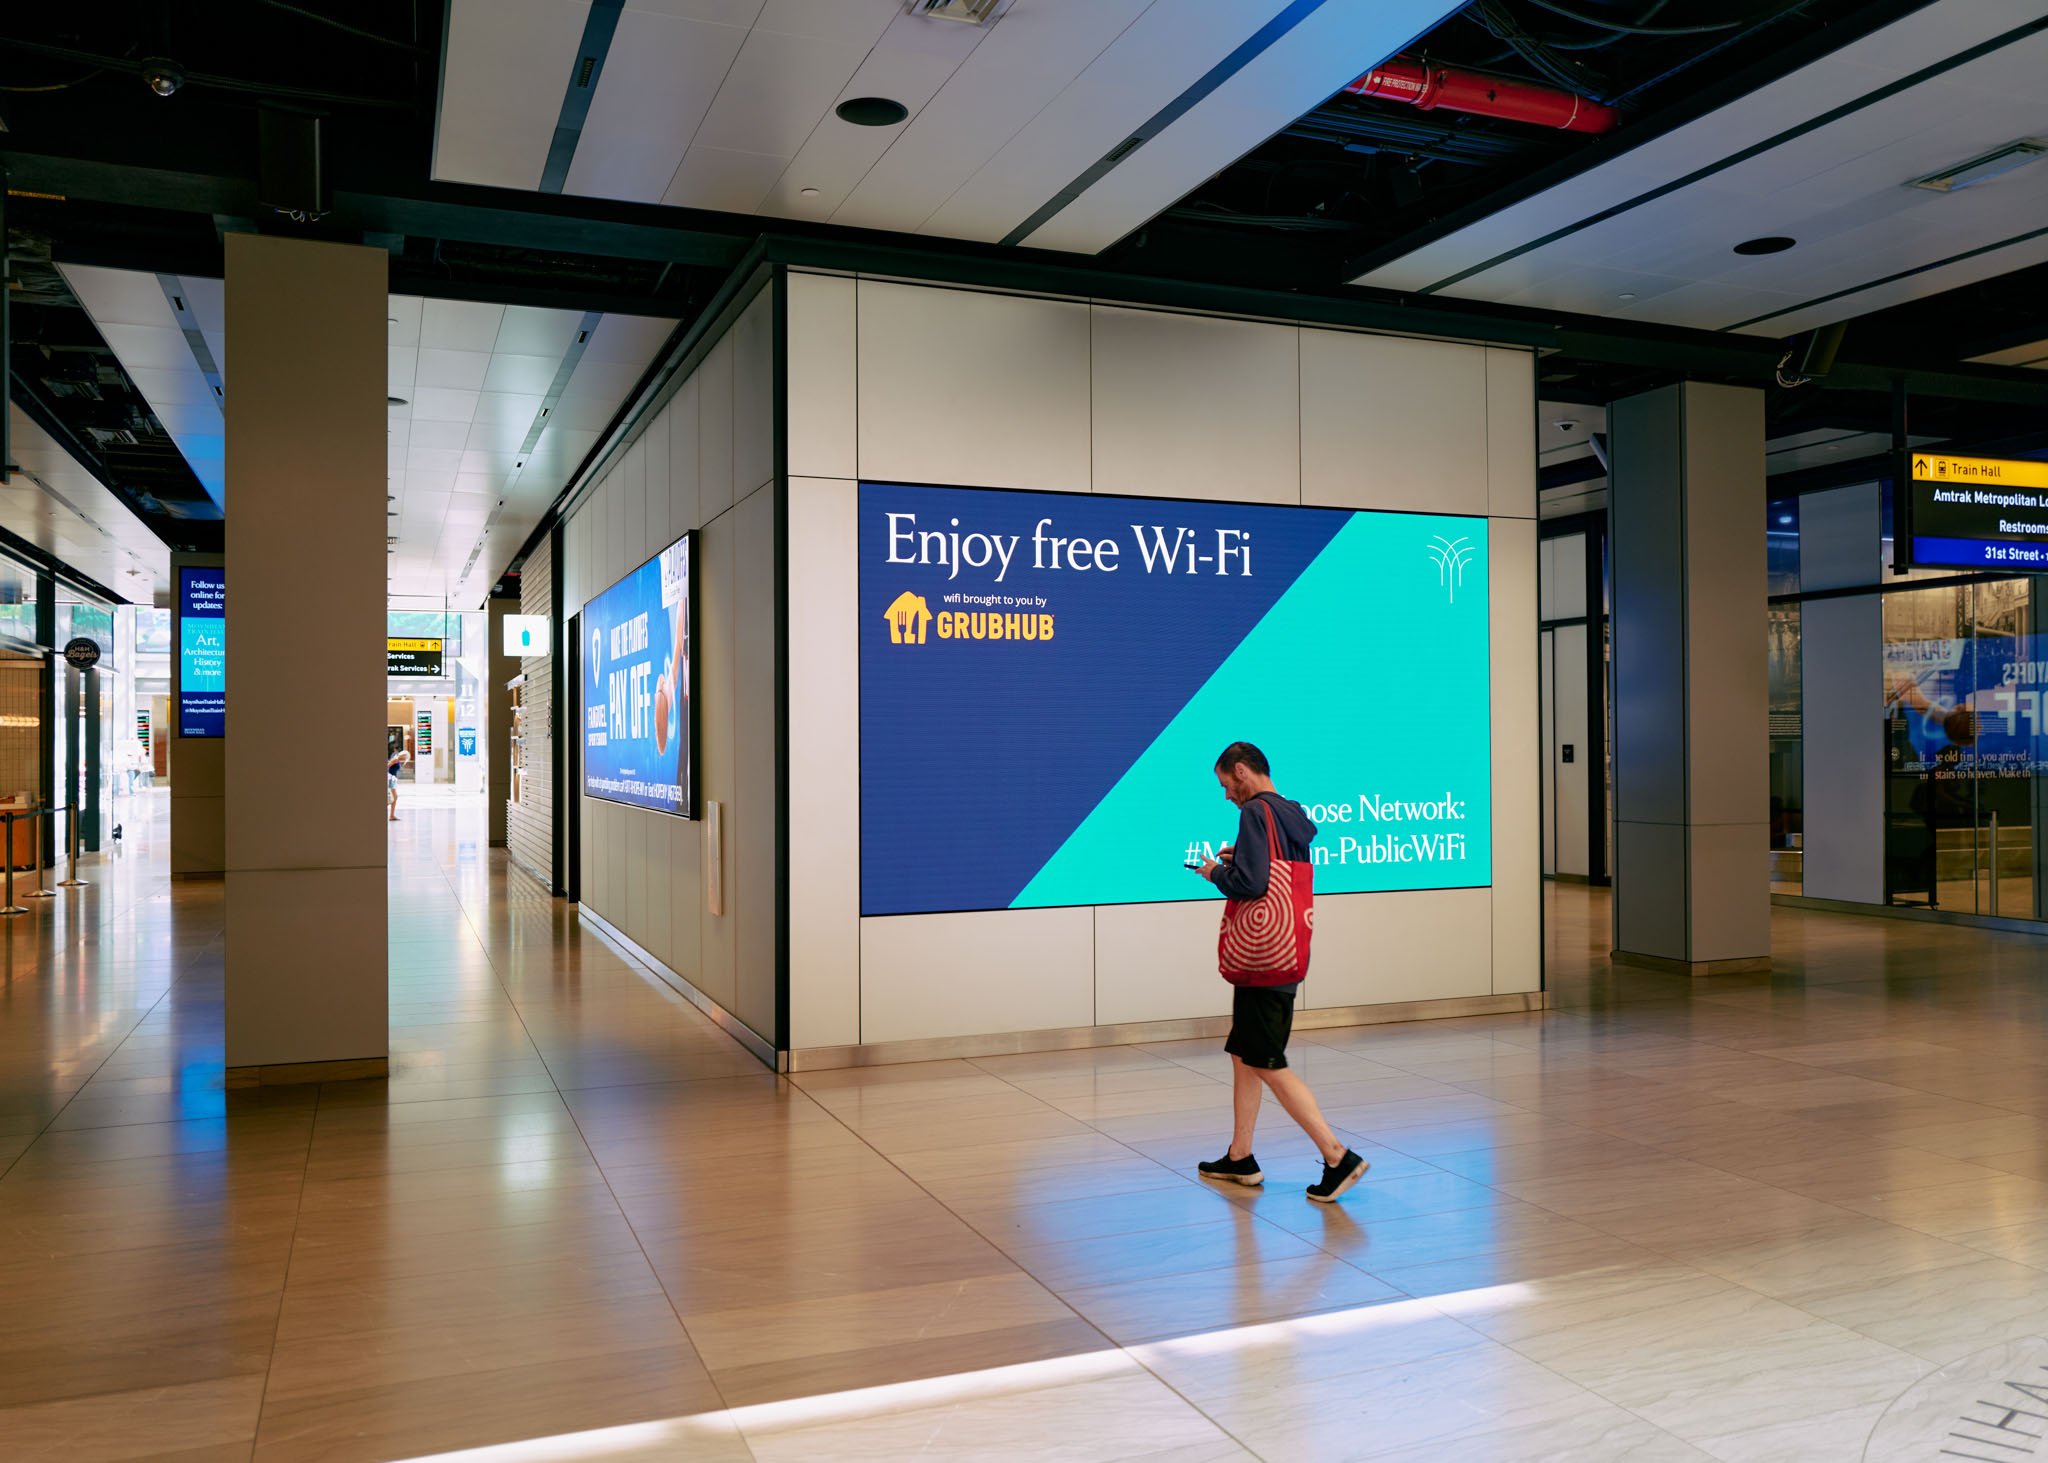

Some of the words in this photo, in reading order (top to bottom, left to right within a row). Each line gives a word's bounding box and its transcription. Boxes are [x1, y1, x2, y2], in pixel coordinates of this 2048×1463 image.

[1952, 463, 1978, 476] Train
[1981, 465, 2001, 477] Hall
[1933, 488, 1972, 503] Amtrak
[1974, 491, 2037, 508] Metropolitan
[2039, 495, 2048, 507] Lo
[1999, 519, 2048, 534] Restrooms
[885, 512, 1020, 582] Enjoy
[1032, 518, 1120, 572] free
[1130, 524, 1253, 577] Wi-Fi
[1985, 546, 2006, 559] 31st
[2009, 547, 2039, 561] Street
[191, 581, 215, 589] Follow
[190, 590, 213, 599] online
[215, 591, 225, 599] for
[943, 593, 960, 603] wifi
[963, 593, 1001, 607] brought
[1003, 596, 1013, 605] to
[1015, 599, 1033, 607] you
[1035, 596, 1047, 608] by
[193, 601, 223, 610] updates:
[937, 611, 1055, 641] GRUBHUB
[68, 648, 97, 661] Bagels
[184, 648, 225, 656] Architectur
[194, 658, 221, 667] History
[610, 667, 627, 740] PAY
[630, 661, 651, 740] OFF
[460, 704, 475, 717] 12
[1944, 750, 1958, 762] old
[1982, 752, 1997, 764] you
[1998, 750, 2027, 761] arrived
[1935, 768, 1956, 780] stairs
[1957, 770, 1967, 779] to
[1967, 767, 1997, 779] haven.
[1998, 766, 2021, 778] Make
[1359, 791, 1466, 822] Network:
